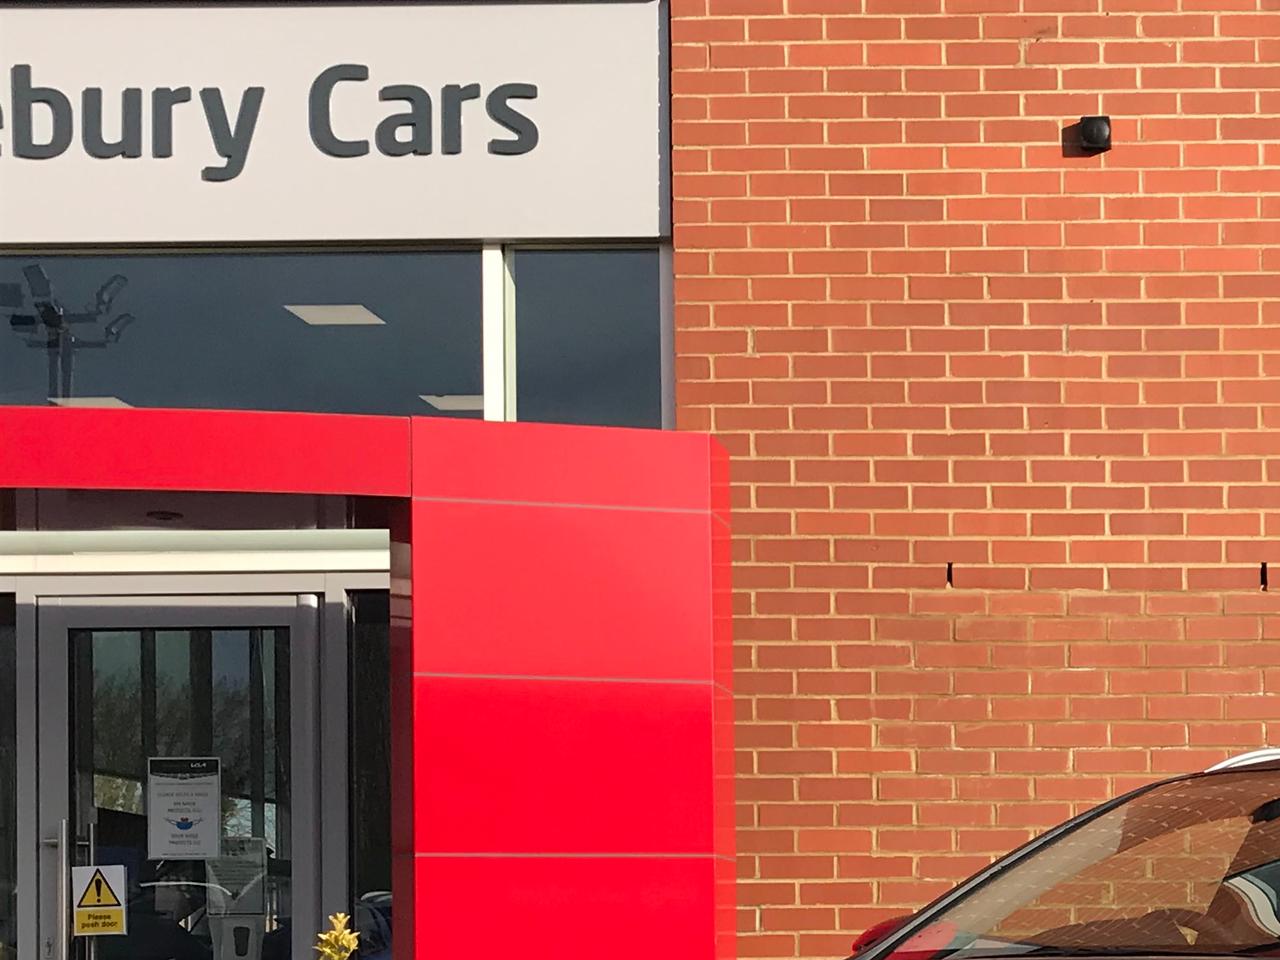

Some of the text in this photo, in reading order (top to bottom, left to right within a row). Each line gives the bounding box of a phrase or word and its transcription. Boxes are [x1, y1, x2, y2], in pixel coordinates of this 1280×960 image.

[0, 63, 539, 182] bury Cars
[87, 912, 112, 921] Please
[80, 920, 118, 929] push door
